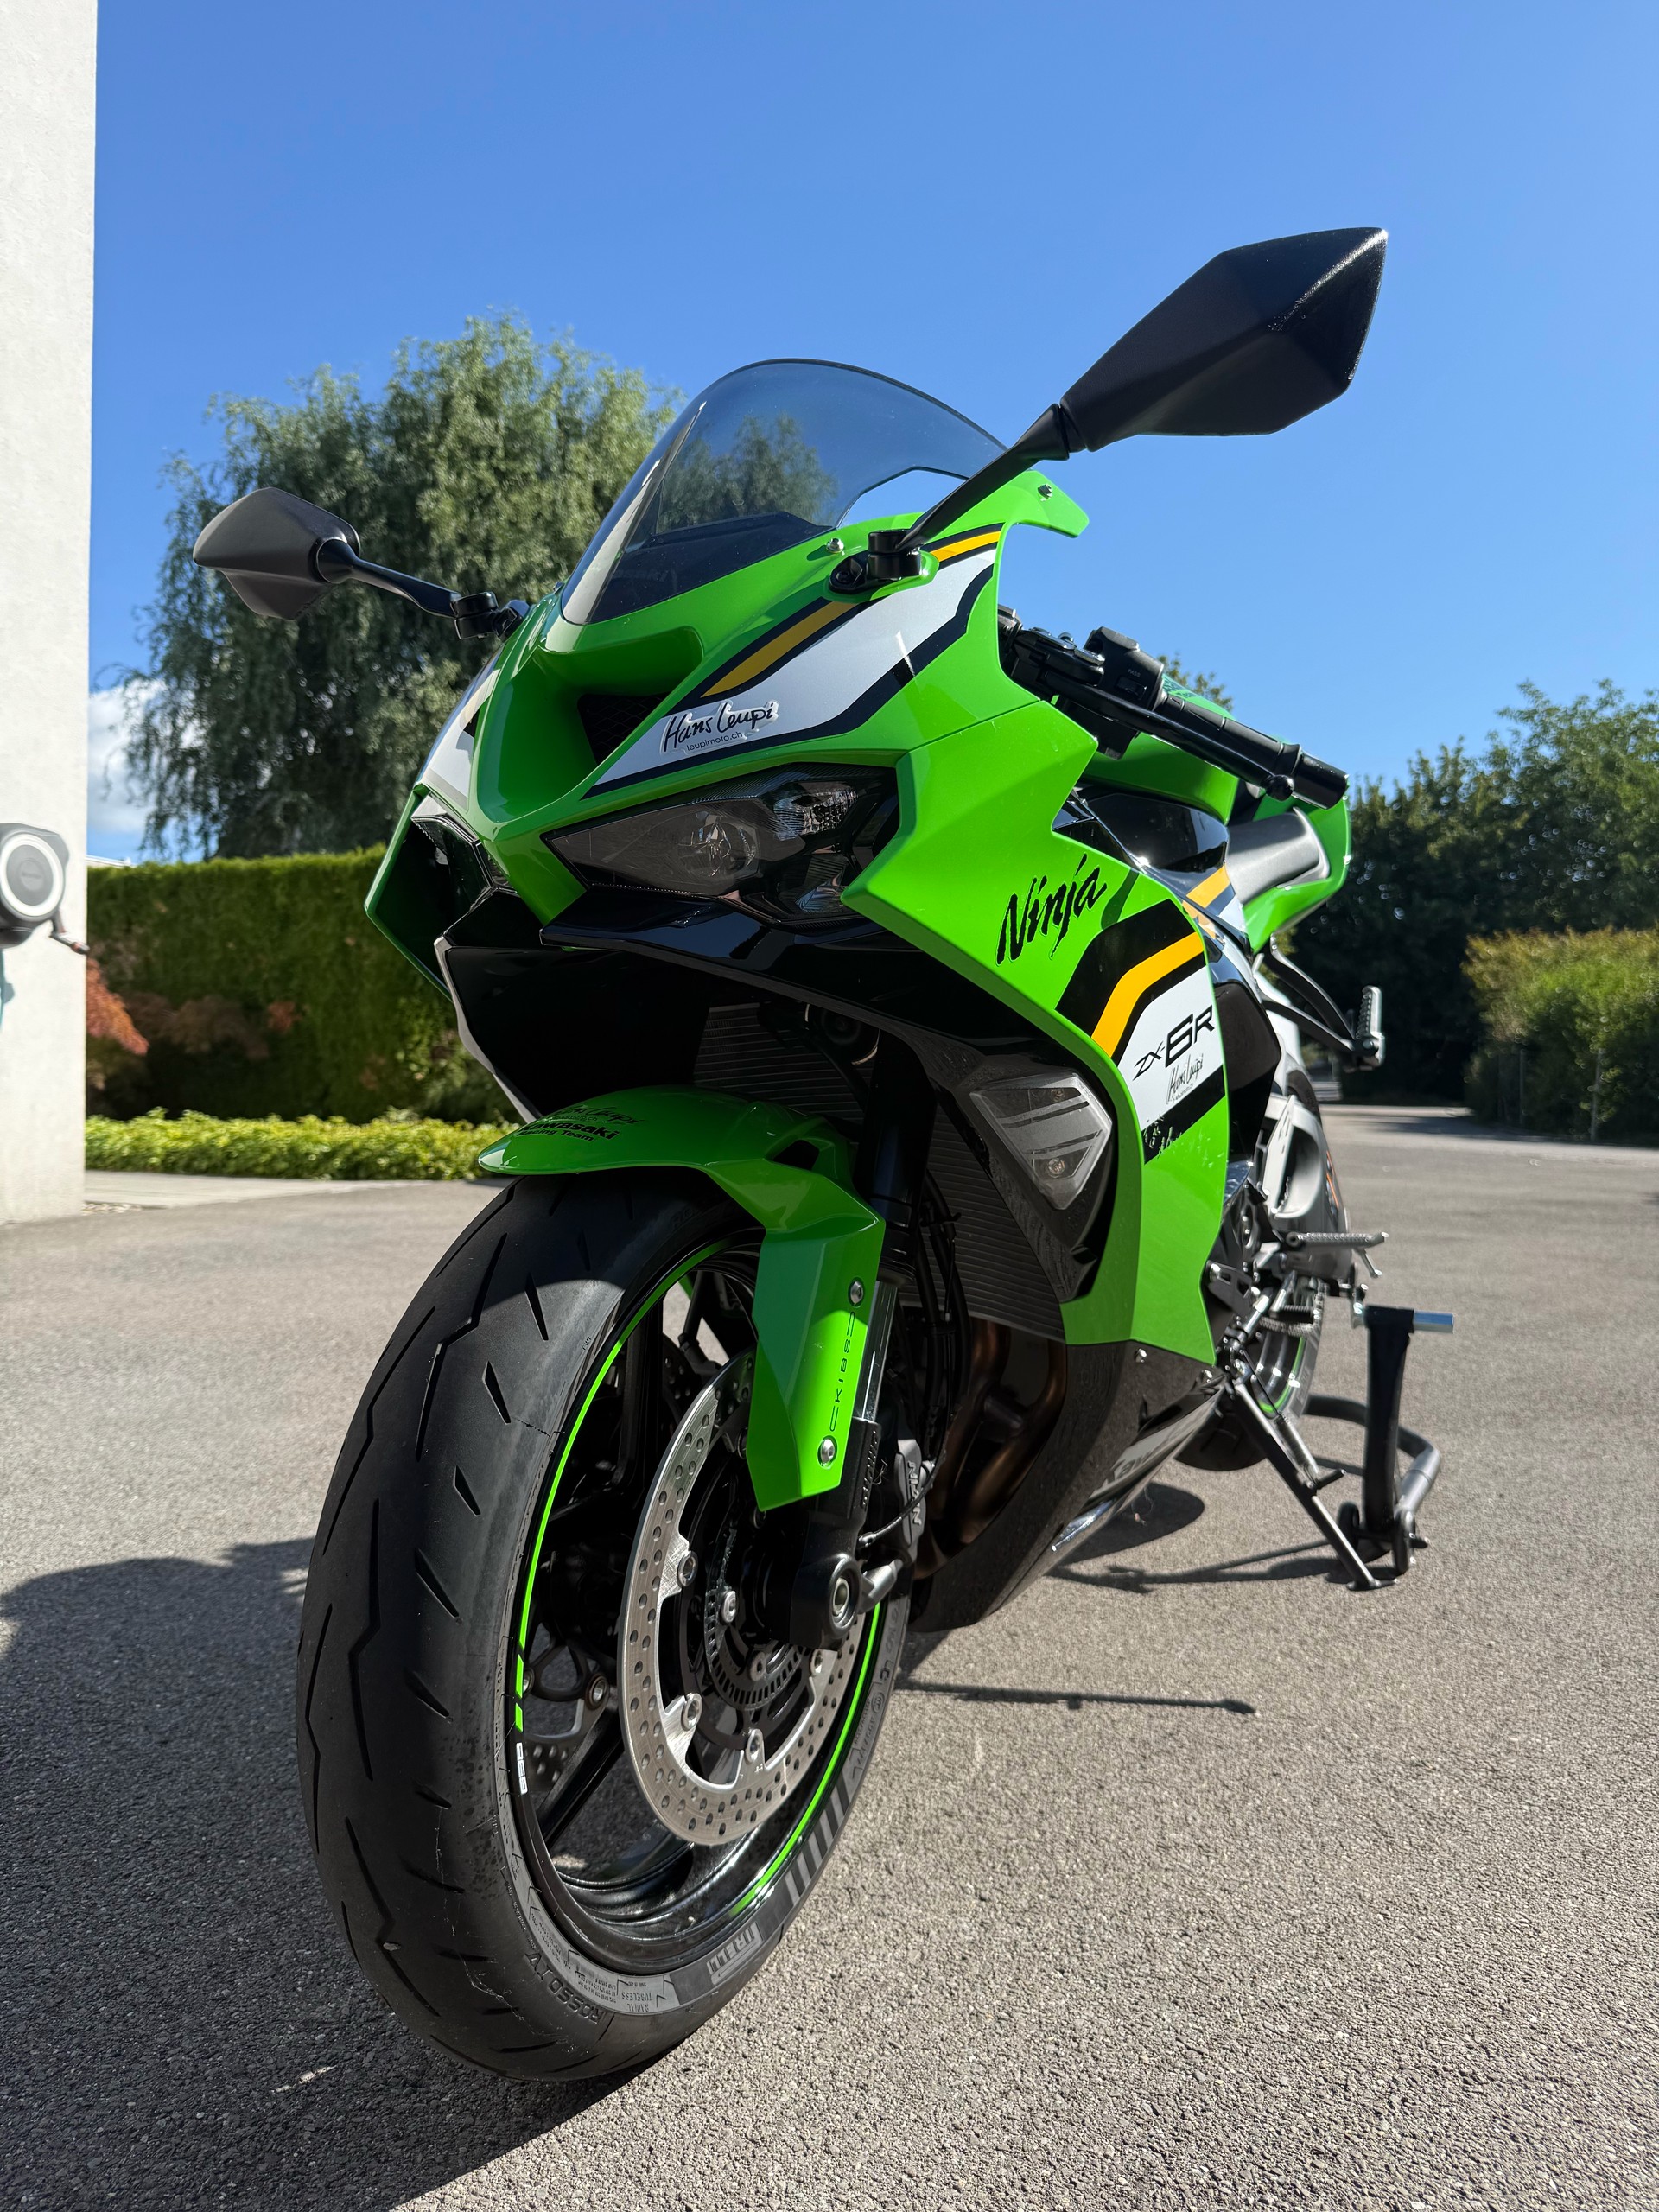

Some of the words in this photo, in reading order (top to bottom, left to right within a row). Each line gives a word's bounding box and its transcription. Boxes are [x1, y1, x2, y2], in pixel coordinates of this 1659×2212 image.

[664, 713, 713, 753] Hans
[716, 702, 774, 734] Leupi
[686, 730, 743, 752] leupimoto.ch
[996, 852, 1108, 965] Ninja
[1132, 1004, 1216, 1081] ZX-6R
[520, 1122, 621, 1141] Kawasaki
[561, 1130, 595, 1142] Team
[834, 1338, 851, 1403] KIBS
[706, 1921, 763, 1985] PIRELLI
[549, 1979, 605, 2024] ROSSO
